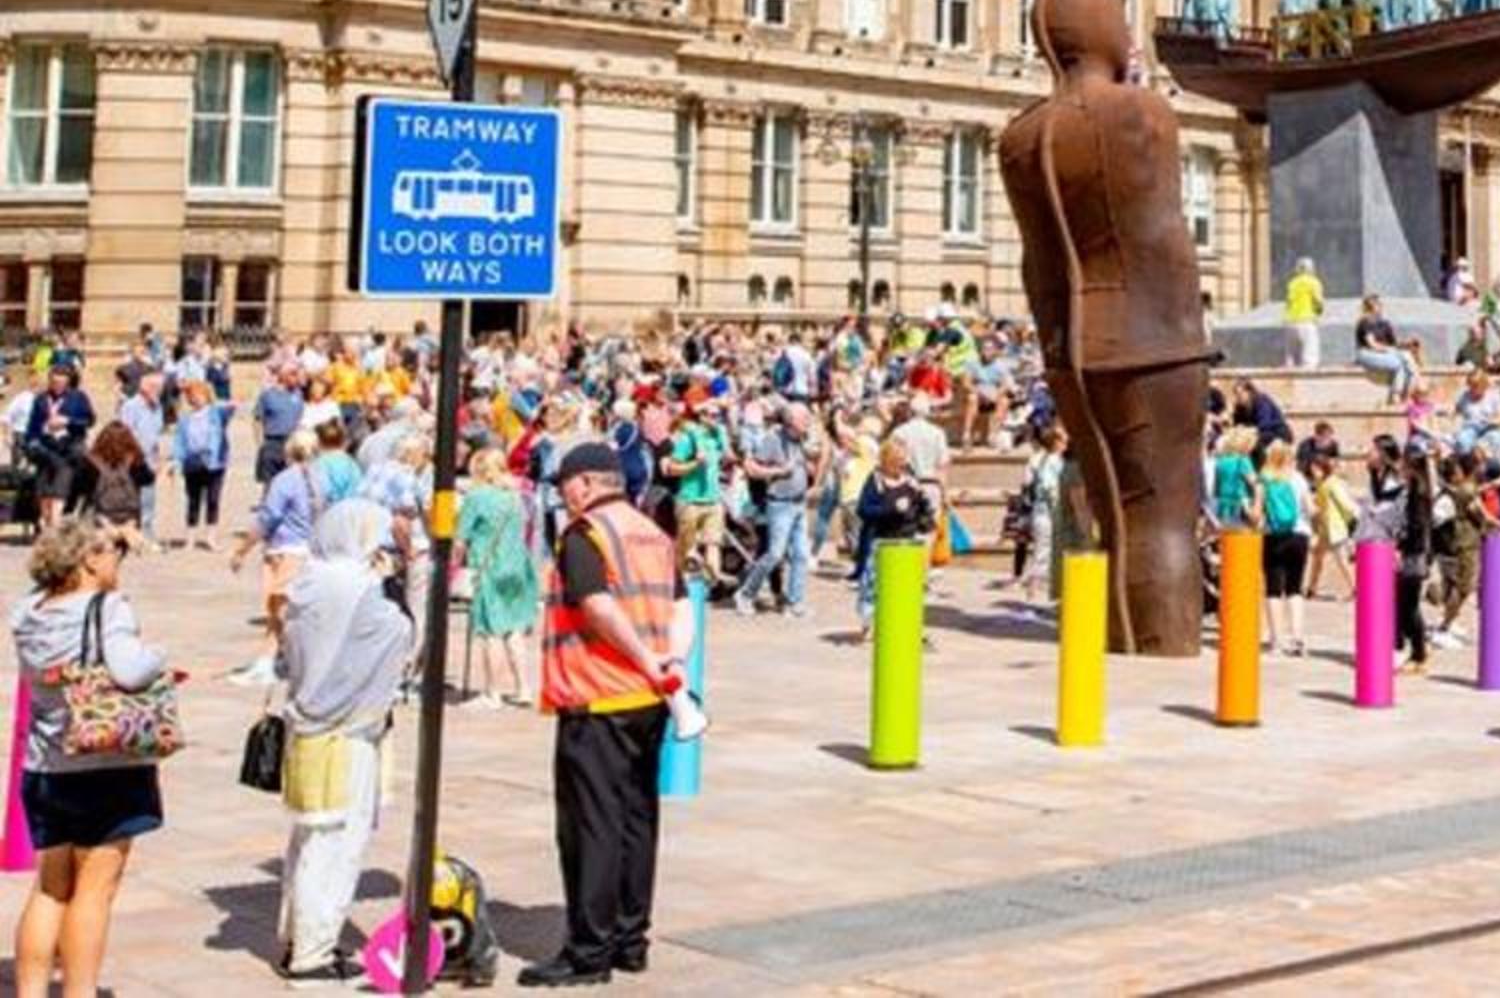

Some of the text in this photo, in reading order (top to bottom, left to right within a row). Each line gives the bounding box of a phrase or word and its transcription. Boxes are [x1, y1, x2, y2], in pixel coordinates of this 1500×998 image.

[395, 115, 538, 145] TRAMWAY
[378, 230, 545, 257] LOOK BOTH
[421, 260, 502, 284] WAYS
